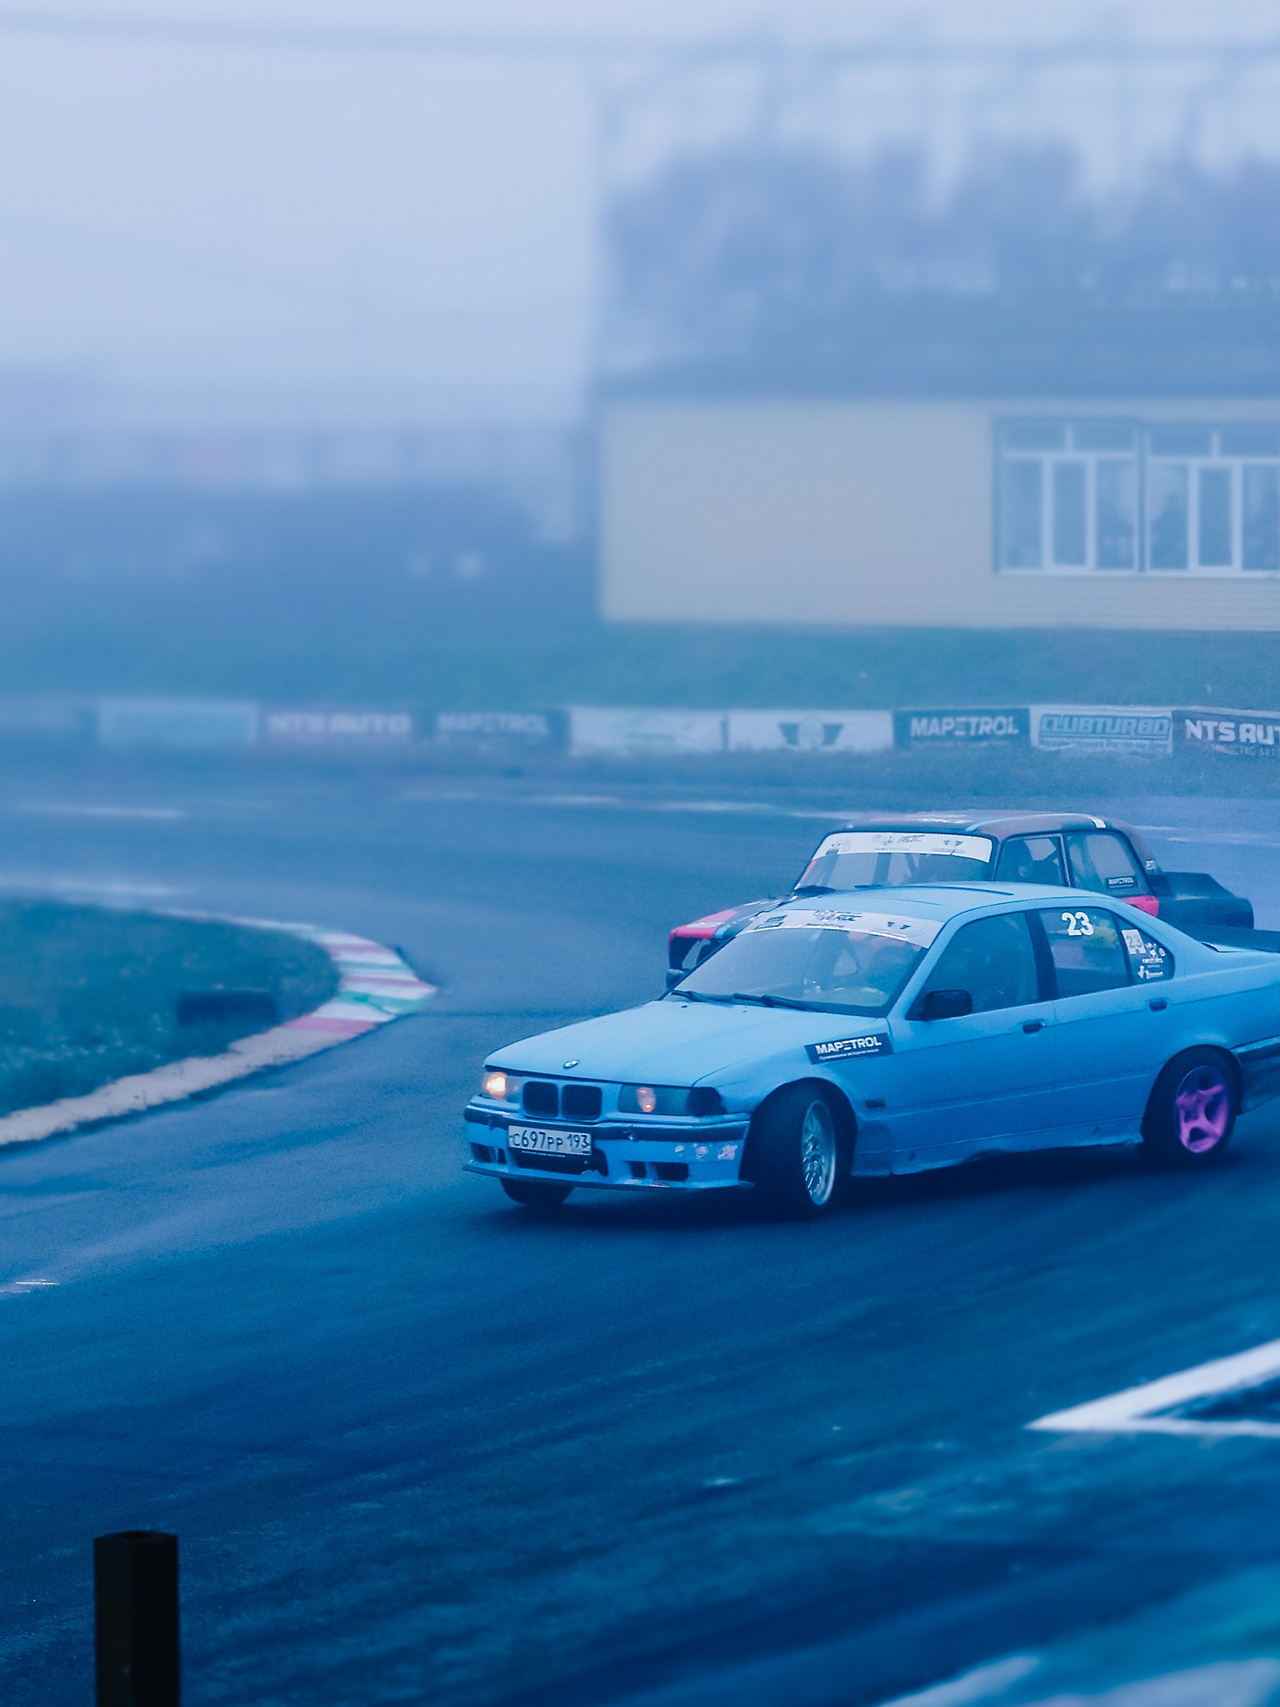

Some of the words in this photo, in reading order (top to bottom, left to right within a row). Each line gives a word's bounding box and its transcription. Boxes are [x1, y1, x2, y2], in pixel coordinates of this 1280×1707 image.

[910, 716, 1019, 737] MAPETROL
[1061, 911, 1095, 936] 23
[815, 1036, 882, 1055] MAPETROL
[566, 1133, 590, 1149] 193
